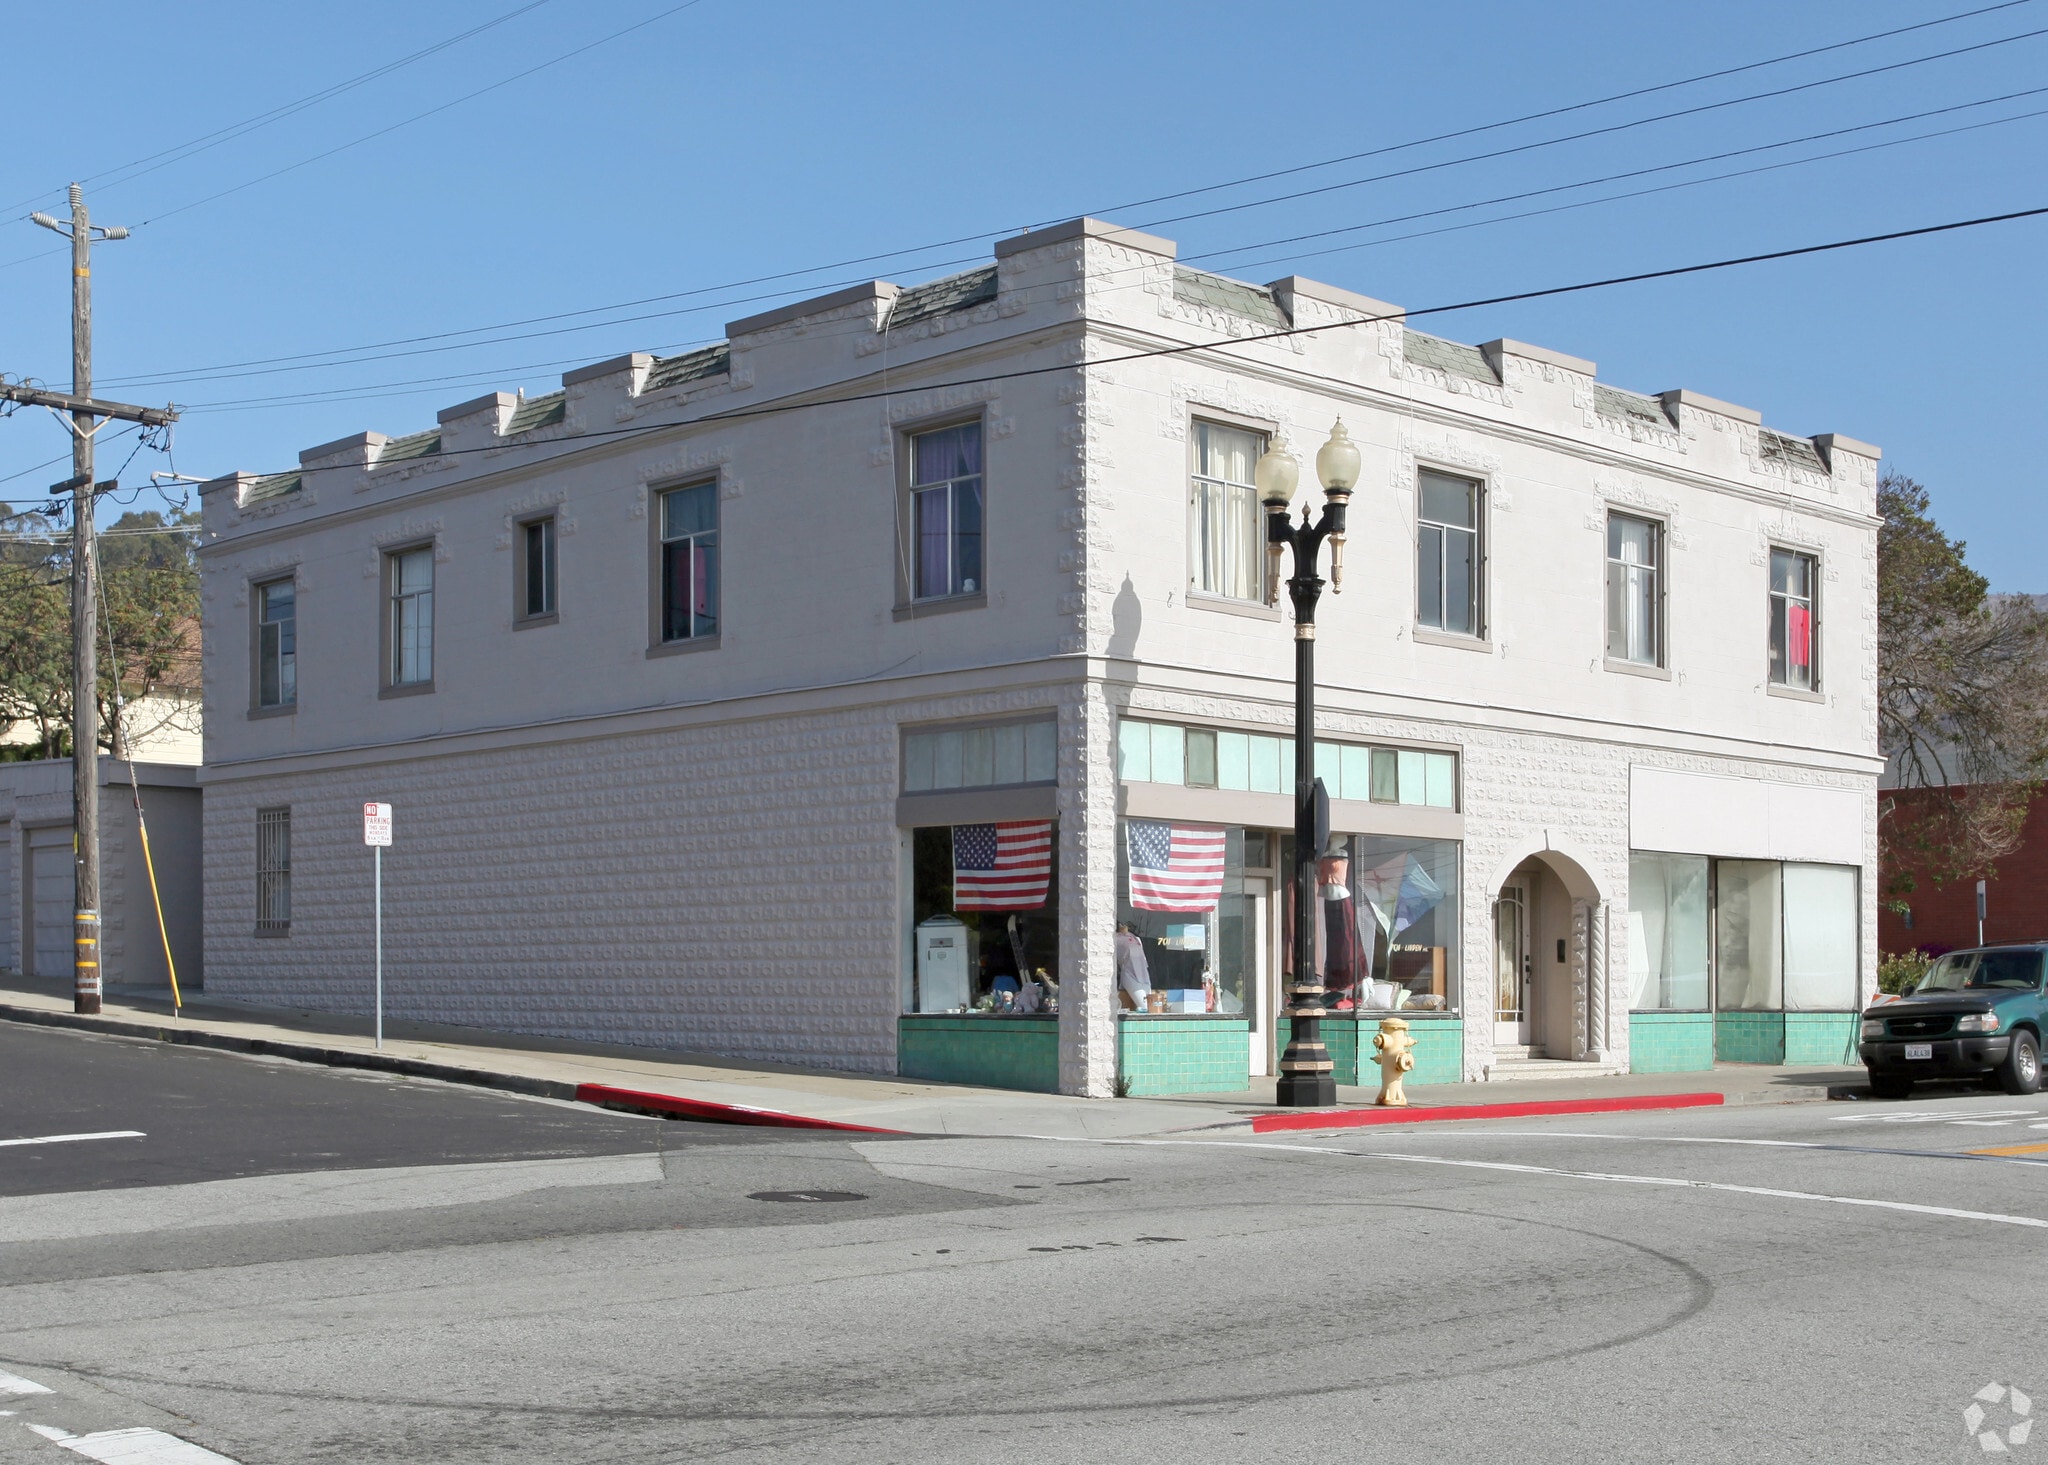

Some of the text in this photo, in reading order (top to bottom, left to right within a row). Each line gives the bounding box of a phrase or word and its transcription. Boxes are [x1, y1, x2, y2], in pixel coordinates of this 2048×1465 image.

[367, 806, 376, 814] NO
[366, 817, 390, 825] PARKING
[1157, 937, 1171, 946] 701
